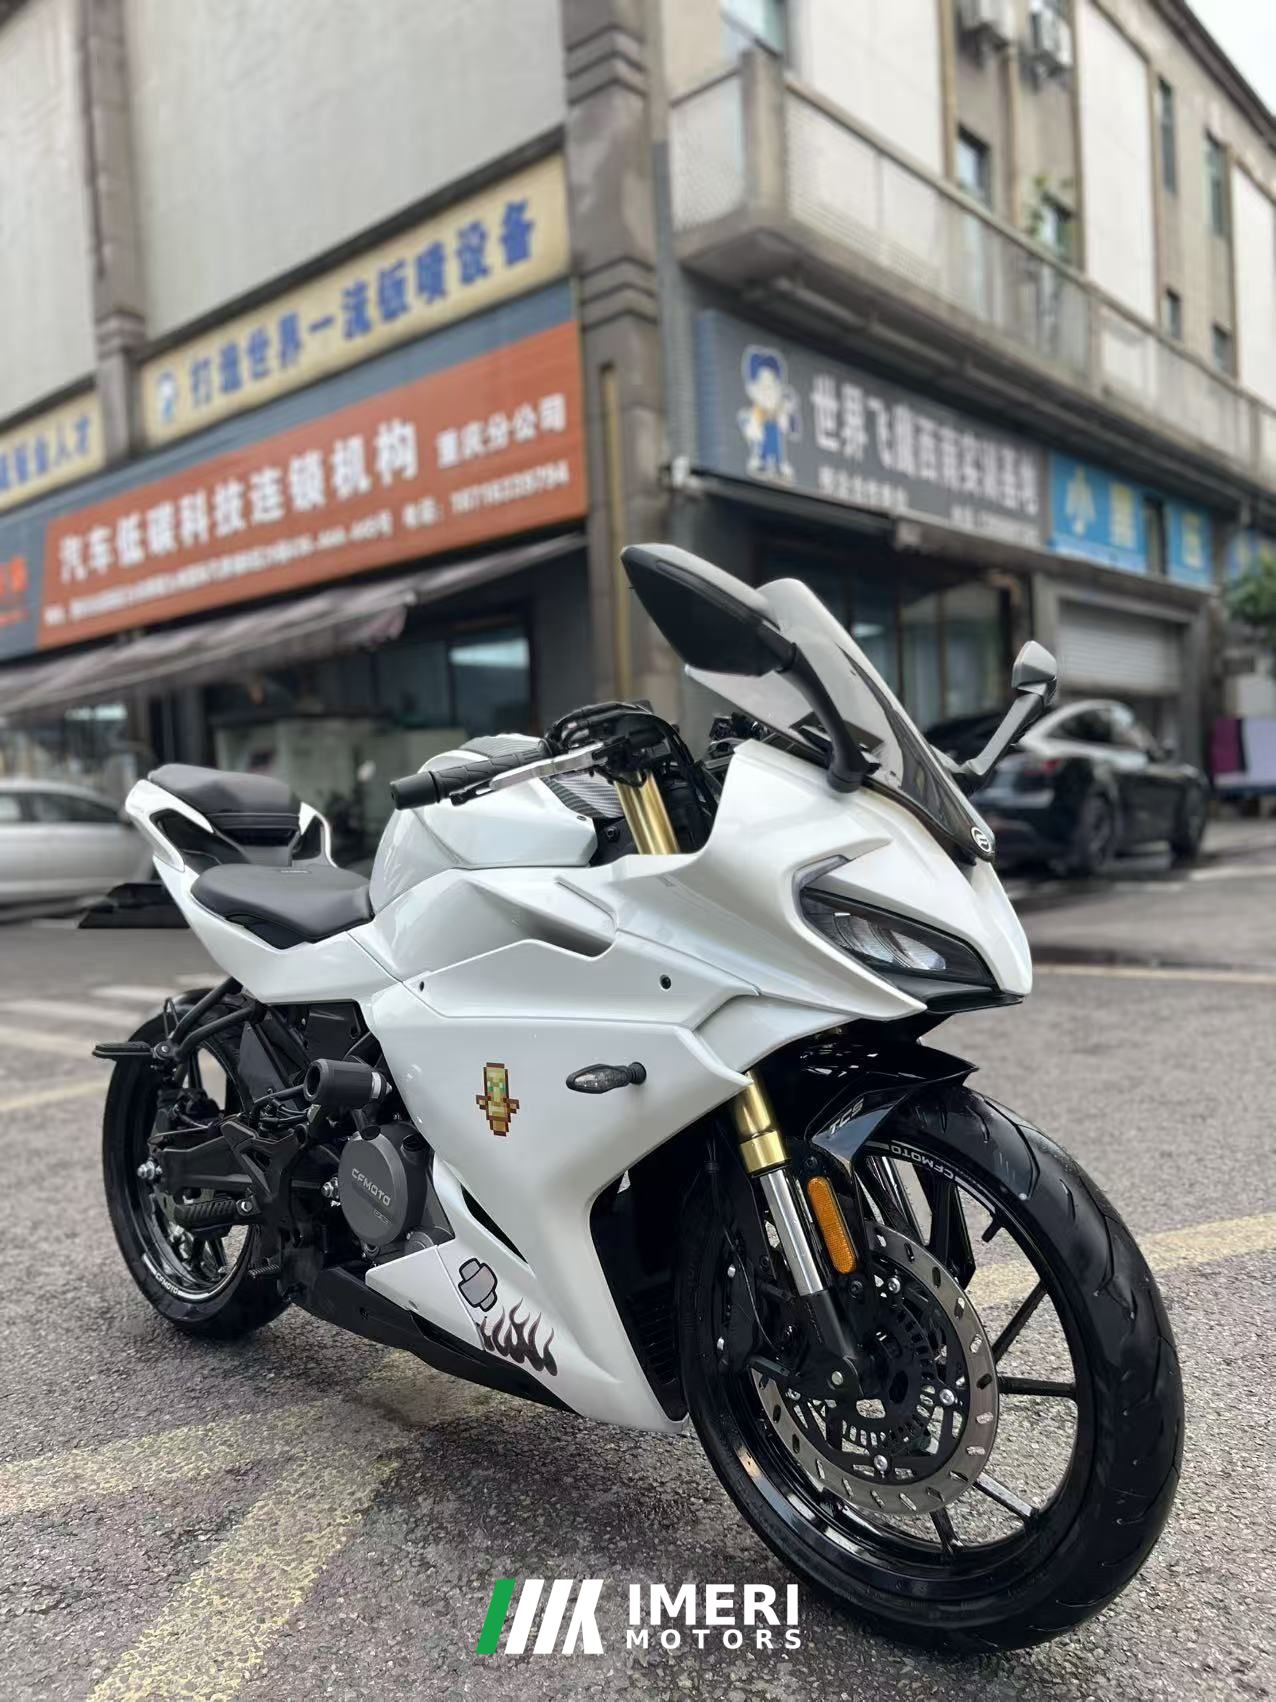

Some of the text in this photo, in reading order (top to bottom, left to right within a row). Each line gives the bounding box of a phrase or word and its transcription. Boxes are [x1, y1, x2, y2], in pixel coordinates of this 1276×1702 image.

[59, 417, 419, 583] 汽车低碳科技连锁机构
[435, 391, 566, 469] 重庆分公司
[890, 1145, 955, 1181] CFMOTO
[351, 1167, 392, 1207] CFMOTO
[155, 1272, 179, 1295] CFMOTO
